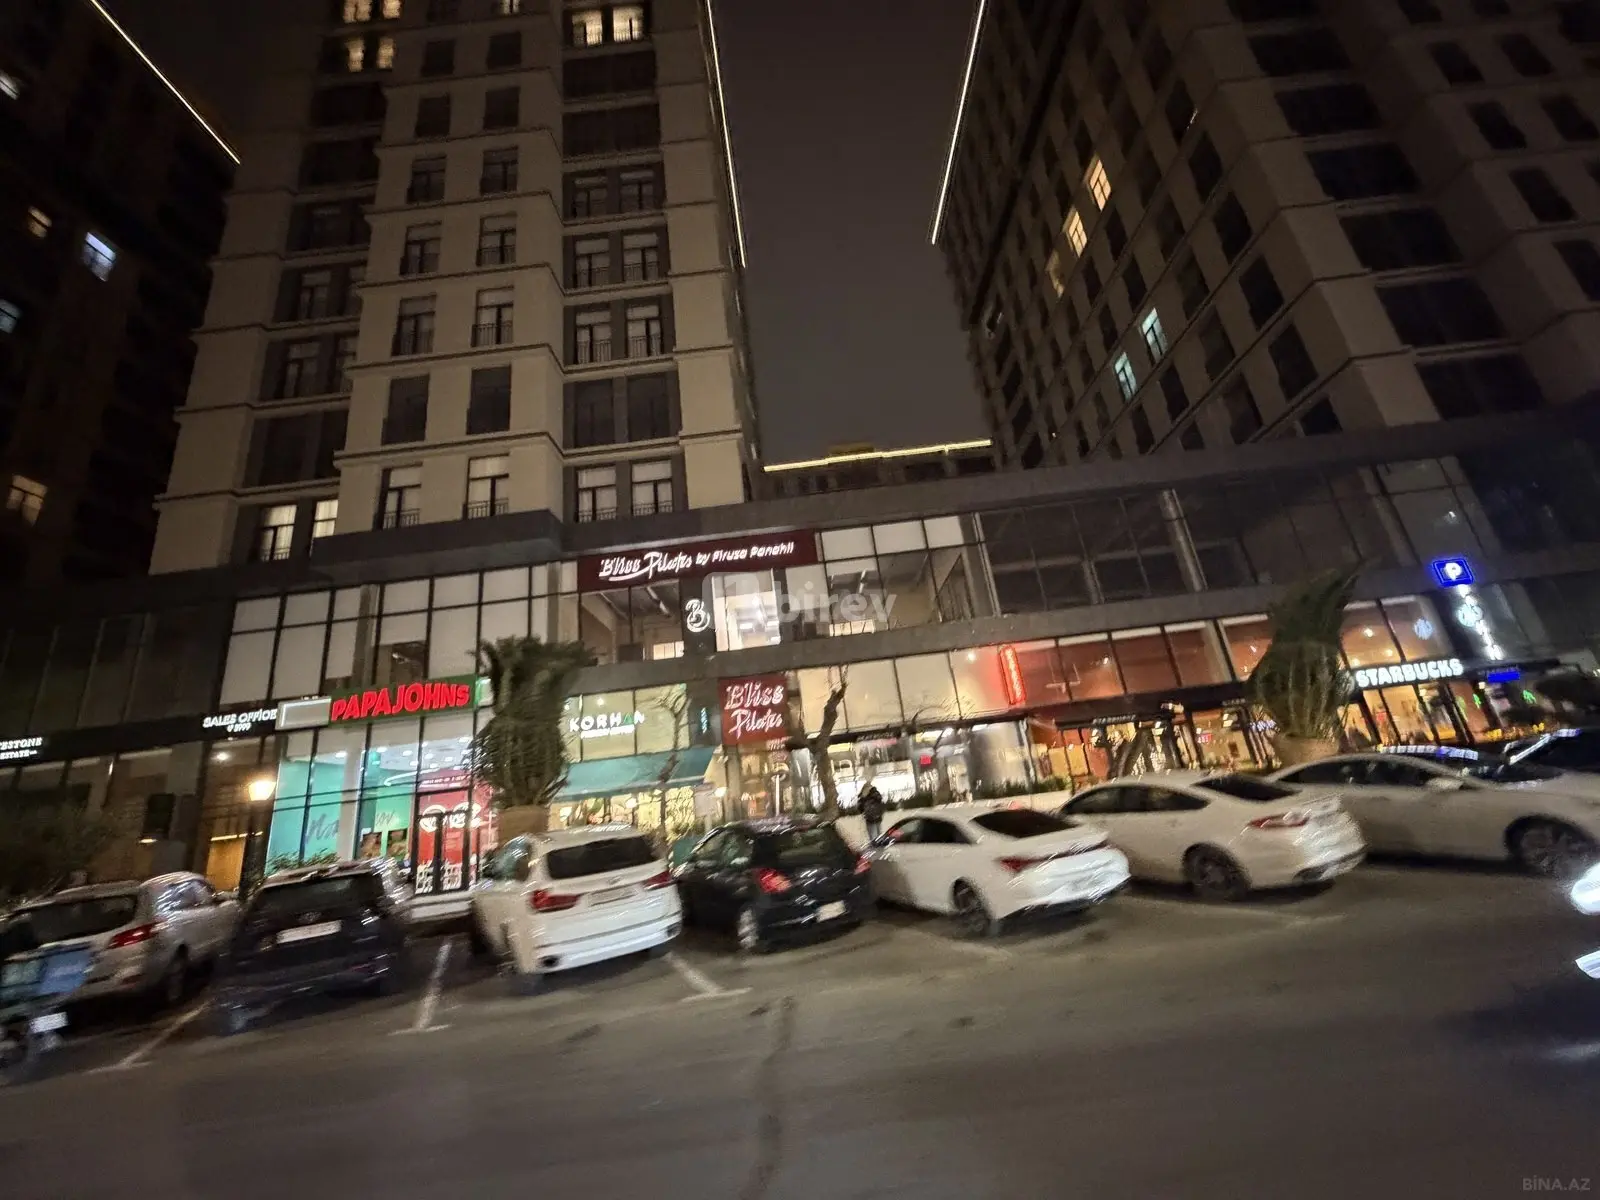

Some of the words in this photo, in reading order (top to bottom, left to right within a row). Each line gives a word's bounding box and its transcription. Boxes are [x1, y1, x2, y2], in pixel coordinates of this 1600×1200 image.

[625, 551, 692, 580] Pilates
[695, 552, 711, 565] by
[1355, 659, 1463, 687] STARBUCKS
[724, 682, 784, 709] Bliss
[203, 714, 237, 728] SALES
[238, 708, 278, 723] OFFICE
[569, 710, 645, 732] KORHAN
[728, 708, 783, 739] Pilates
